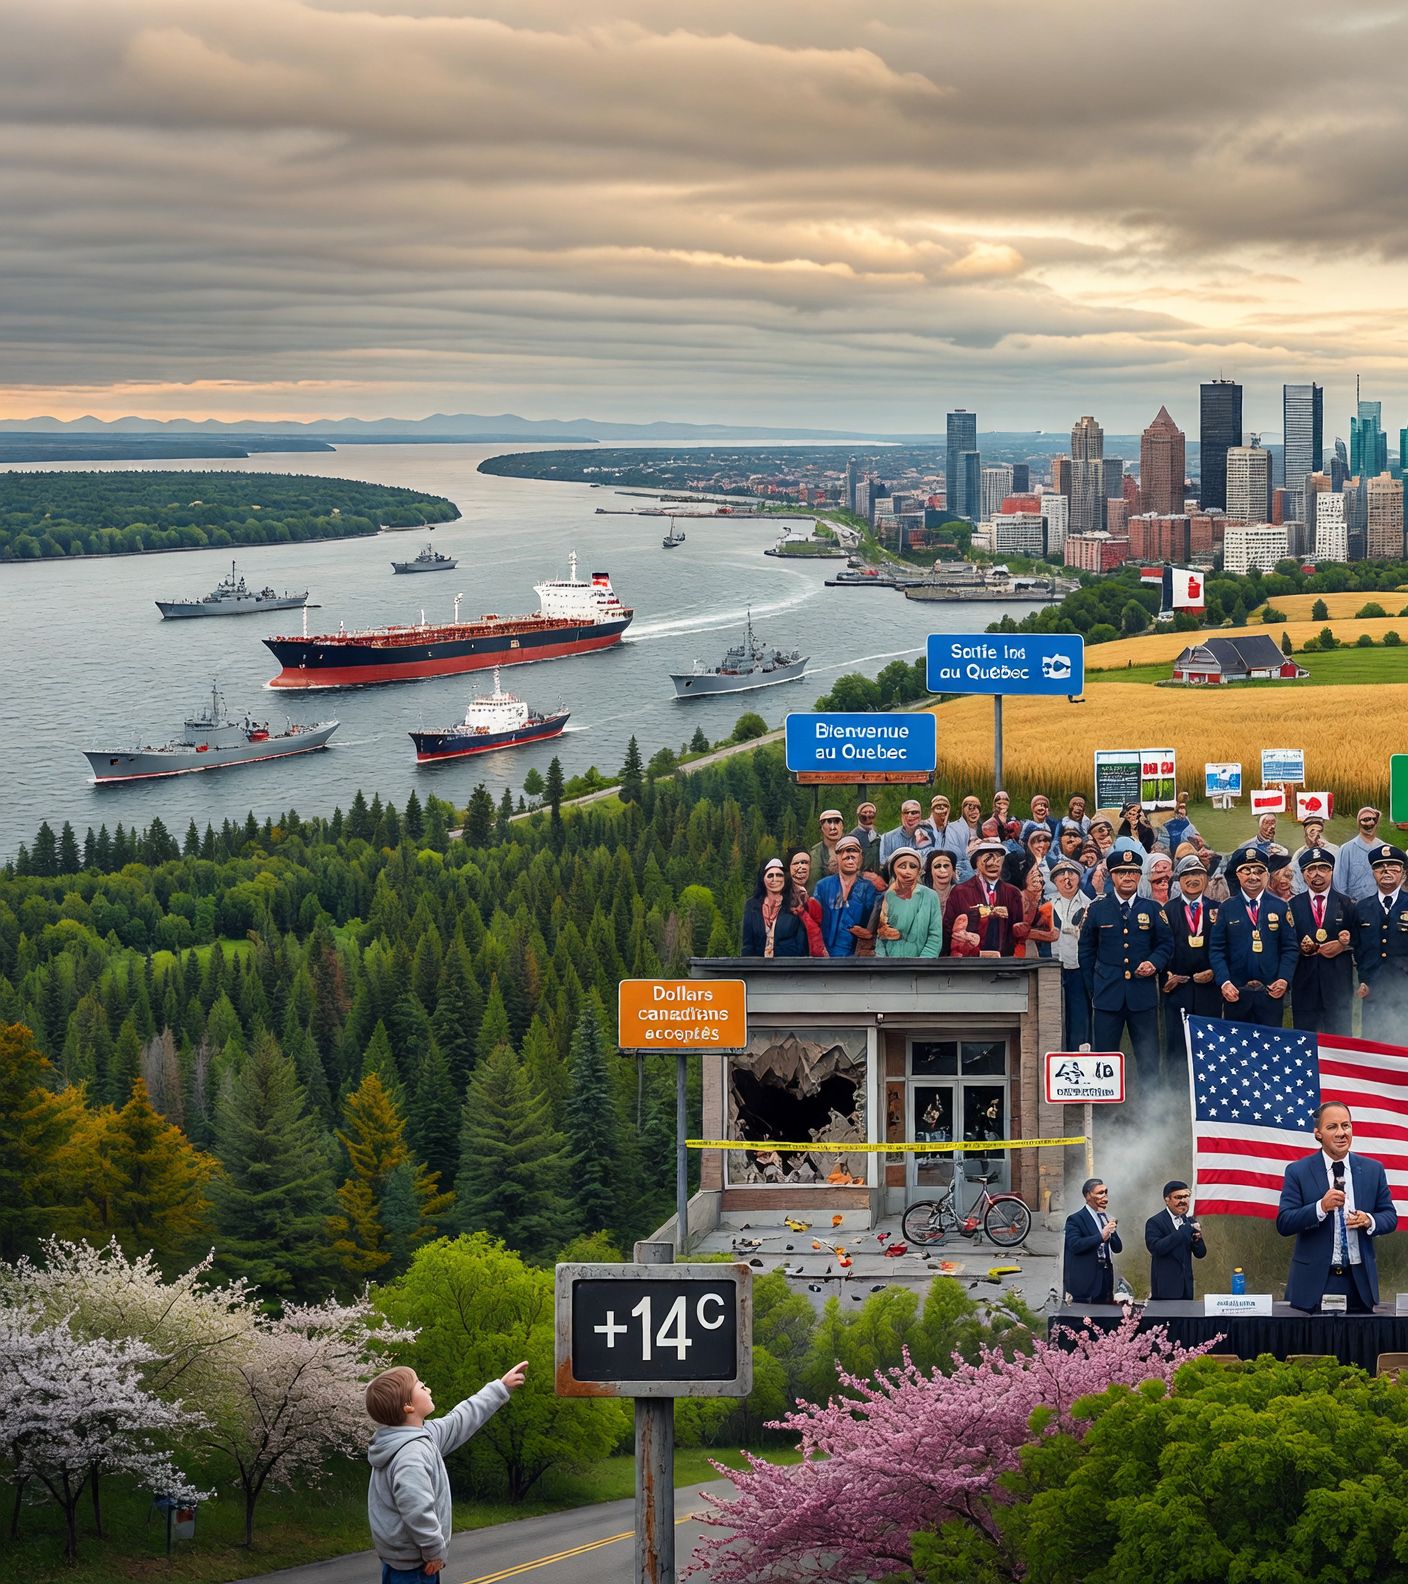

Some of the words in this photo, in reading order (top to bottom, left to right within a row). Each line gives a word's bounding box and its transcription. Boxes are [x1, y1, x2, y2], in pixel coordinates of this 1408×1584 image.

[940, 667, 961, 679] au
[815, 747, 836, 759] au
[653, 985, 713, 1001] Dollars
